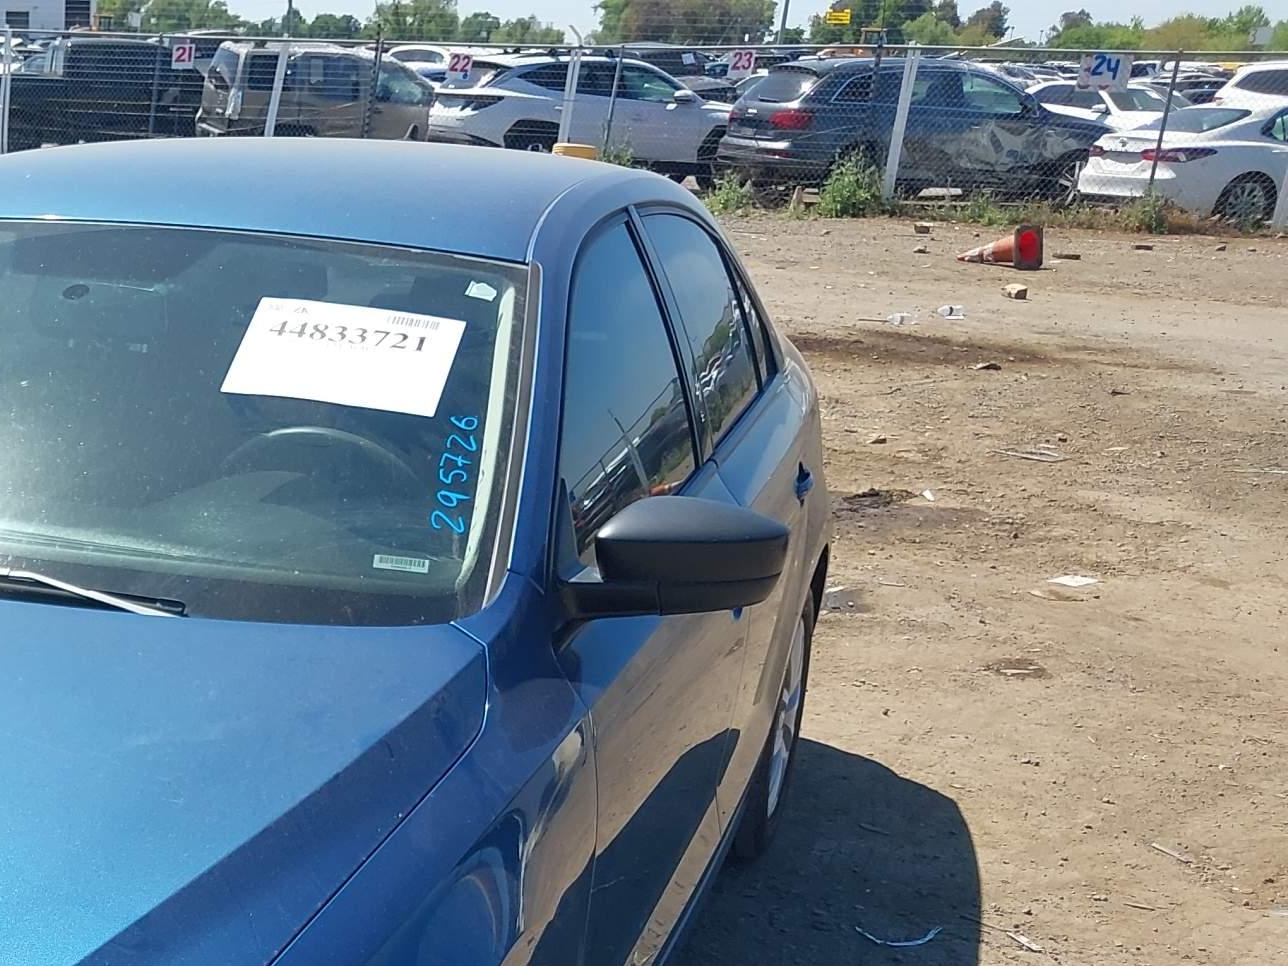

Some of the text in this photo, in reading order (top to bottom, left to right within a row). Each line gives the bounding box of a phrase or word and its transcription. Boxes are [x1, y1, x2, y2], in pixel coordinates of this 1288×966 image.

[174, 46, 193, 63] 21
[449, 54, 471, 73] 22
[731, 51, 754, 71] 23
[1091, 54, 1121, 80] 24
[268, 320, 427, 352] 44833721
[430, 415, 479, 534] 295726
